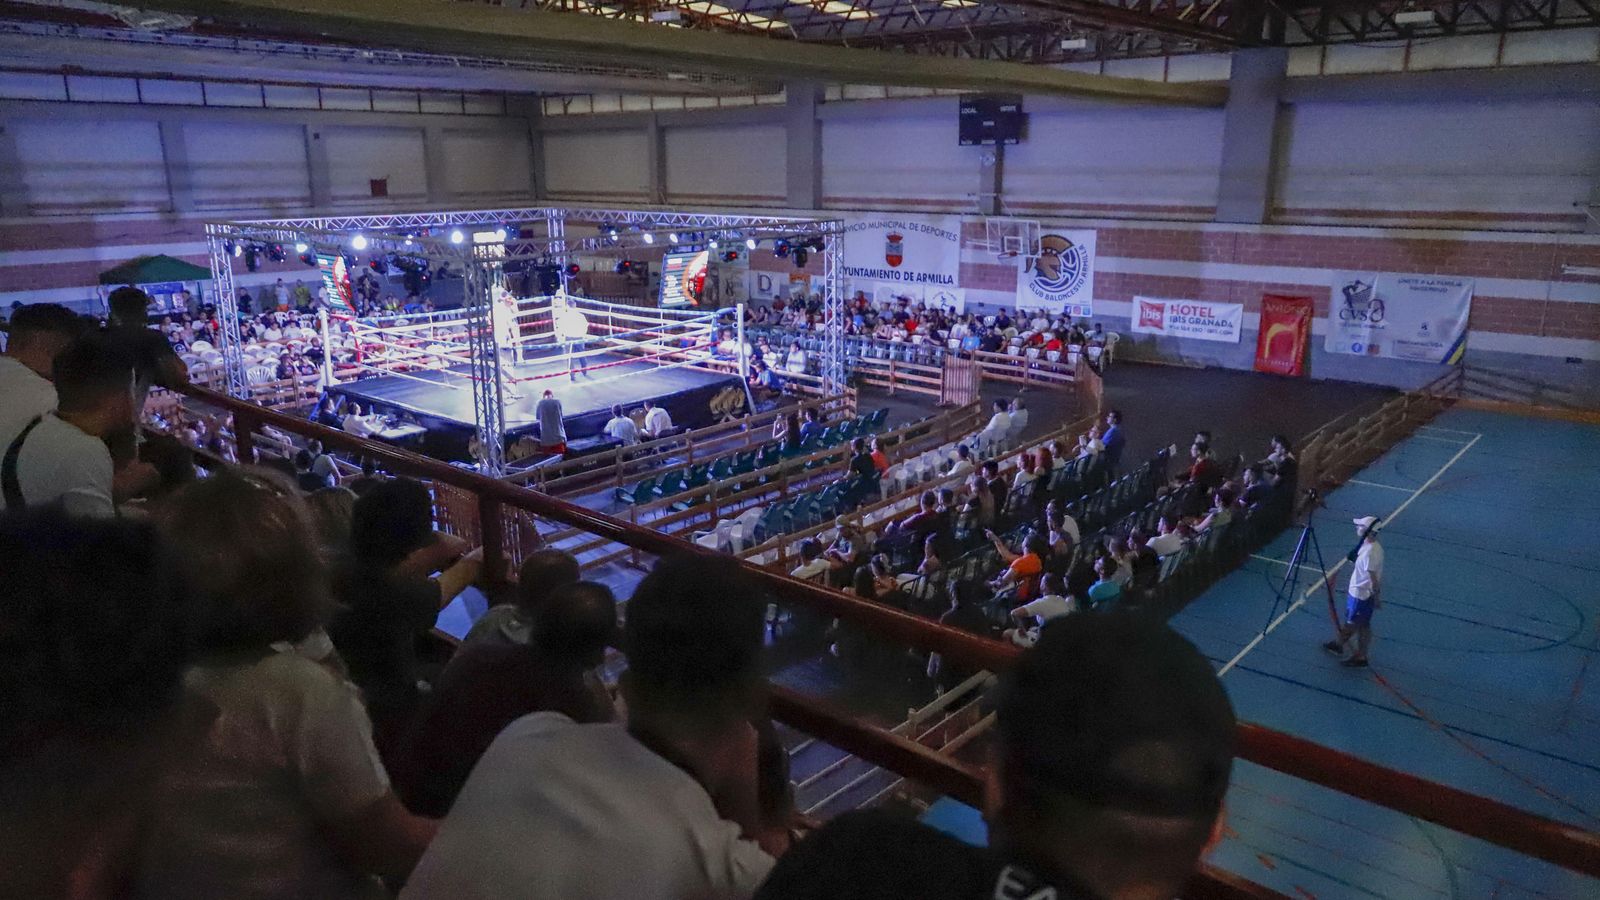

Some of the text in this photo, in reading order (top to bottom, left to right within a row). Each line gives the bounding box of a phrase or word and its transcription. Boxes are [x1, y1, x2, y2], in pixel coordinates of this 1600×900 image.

[868, 221, 906, 230] MUNICIPAL
[909, 222, 919, 231] DE
[920, 223, 958, 242] DEPORTES
[904, 271, 914, 281] DE
[916, 272, 954, 285] ARMILLA
[1029, 282, 1044, 298] CLUB
[1045, 278, 1085, 302] BALONCESTO
[1143, 308, 1161, 320] ibis
[1170, 304, 1216, 318] HOTEL
[1169, 315, 1234, 328] IBIS GRANADA
